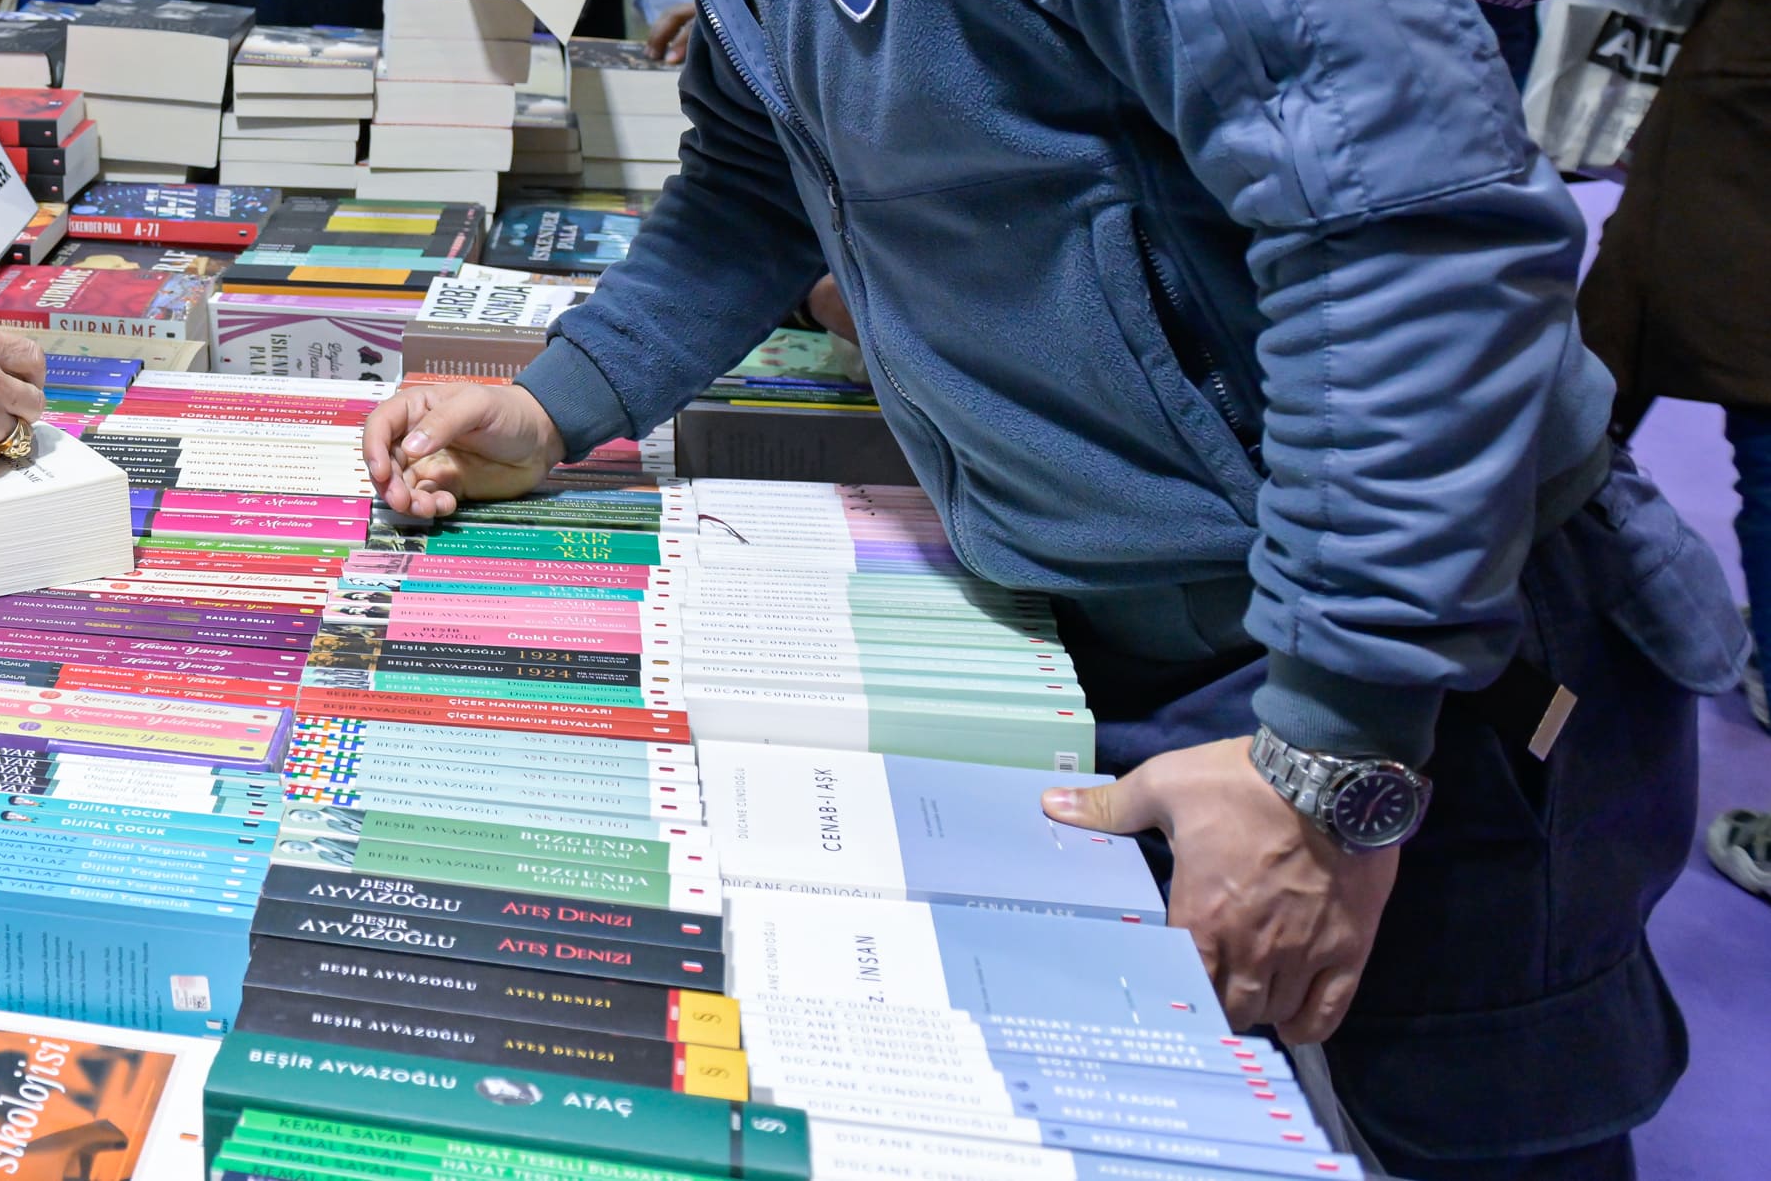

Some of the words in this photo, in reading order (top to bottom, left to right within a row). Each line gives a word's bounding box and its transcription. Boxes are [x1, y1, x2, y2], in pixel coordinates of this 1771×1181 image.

[69, 218, 101, 234] İSKENDER
[103, 221, 122, 234] PALA
[134, 222, 160, 237] A-71
[529, 211, 560, 261] İSKENDER
[556, 224, 578, 251] PALA
[430, 283, 482, 319] DARBE
[423, 556, 456, 564] BEŞİR
[460, 559, 528, 568] AYVAZOĞLU
[13, 600, 43, 609] SİNAN
[45, 602, 87, 612] YAĞMUR
[206, 615, 237, 624] KALEM
[239, 617, 275, 625] ARKASI
[8, 632, 39, 641] SİNAN
[41, 634, 89, 645] YAĞMUR
[507, 630, 548, 642] Öteki
[553, 634, 605, 645] Canlar
[392, 644, 429, 652] BEŞİR
[432, 646, 507, 657] AYVAZOĞLU
[518, 650, 573, 663] 1924
[387, 660, 424, 669] BEŞİR
[427, 662, 504, 673] AYVAZOĞLU
[515, 666, 572, 679] 1924
[448, 698, 486, 708] ÇİÇEK
[488, 700, 548, 712] HANIM'IN
[551, 704, 613, 716] RÜYALARI
[446, 711, 485, 721] ÇİÇEK
[487, 714, 547, 725] HANIM'IN
[550, 717, 613, 730] RÜYALARI
[813, 766, 836, 792] AŞK
[68, 801, 117, 816] DİJİTAL
[120, 806, 171, 821] ÇOCUK
[816, 794, 842, 853] CENAB-I
[61, 817, 110, 832] DİJİTAL
[114, 822, 166, 837] ÇOCUK
[31, 830, 78, 843] YALAZ
[92, 837, 136, 851] Dijital
[139, 842, 208, 859] Yorgunluk
[519, 830, 649, 855] BOZGUNDA
[359, 877, 415, 894] BEŞİR
[516, 862, 649, 887] BOZGUNDA
[8, 881, 56, 894] YALAZ
[70, 886, 114, 902] Dijital
[118, 892, 192, 910] Yorgunluk
[308, 883, 462, 913] AYVAZOĞLU
[501, 900, 551, 920] ATEŞ
[556, 905, 632, 928] DENİZİ
[351, 913, 408, 931] BEŞİR
[298, 918, 457, 950] AYVAZOĞLU
[498, 936, 549, 958] ATEŞ
[554, 942, 632, 965] DENİZİ
[855, 933, 882, 982] İNSAN
[320, 961, 368, 978] BEŞİR
[374, 967, 478, 992] AYVAZOĞLU
[504, 985, 546, 1002] ATEŞ
[551, 991, 612, 1009] DENİZİ
[312, 1012, 363, 1030] BEŞİR
[368, 1019, 477, 1045] AYVAZOĞLU
[504, 1037, 547, 1055] ATEŞ
[551, 1042, 616, 1064] DENİZİ
[248, 1048, 313, 1071] BEŞİR
[318, 1057, 458, 1091] AYVAZOĞLU
[563, 1091, 635, 1119] ATAÇ
[278, 1116, 345, 1139] KEMAL
[350, 1126, 414, 1148] SAYAR
[446, 1141, 514, 1162] HAYAT
[518, 1150, 585, 1173] TESELLİ
